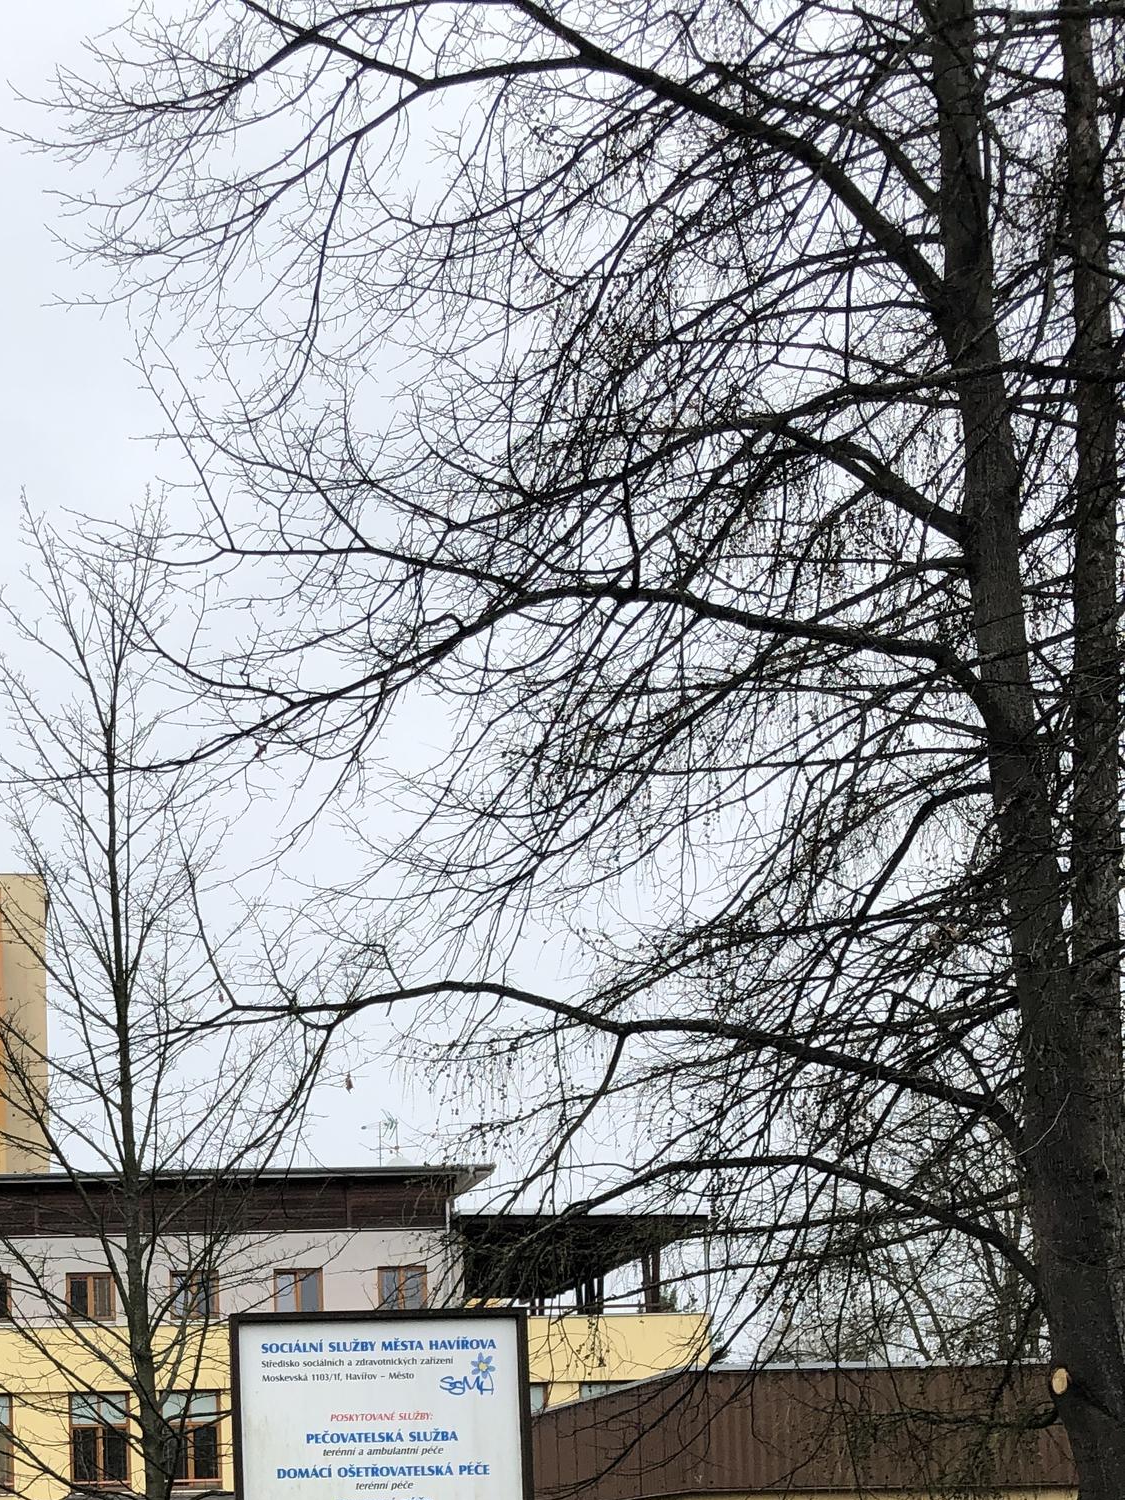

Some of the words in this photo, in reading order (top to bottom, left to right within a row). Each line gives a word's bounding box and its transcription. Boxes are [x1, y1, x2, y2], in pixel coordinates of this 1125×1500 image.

[261, 1339, 324, 1354] SOCIÁLNÍ
[328, 1338, 377, 1353] SLUŽBY
[381, 1337, 424, 1352] MĚSTA
[428, 1335, 497, 1350] HAVÍŘOVA
[261, 1359, 301, 1368] Středisko
[302, 1358, 345, 1367] sociálních
[355, 1357, 418, 1367] zdravotnických
[419, 1356, 454, 1366] zařízení
[261, 1374, 308, 1383] Moskevská
[345, 1371, 378, 1381] Havířov
[388, 1372, 415, 1380] Město
[330, 1411, 396, 1422] POSKYTOVANÉ
[398, 1410, 434, 1421] SLUŽBY:
[306, 1429, 404, 1445] PEČOVATELSKÁ
[408, 1428, 459, 1443] SLUŽBA
[322, 1447, 357, 1457] terénní
[367, 1446, 419, 1456] ambulantní
[420, 1446, 444, 1457] péče
[276, 1464, 333, 1480] DOMÁCÍ
[337, 1462, 454, 1478] OŠETŘOVATELSKÁ
[459, 1462, 490, 1476] PÉČE
[355, 1481, 388, 1491] terénní
[390, 1481, 414, 1492] péče
